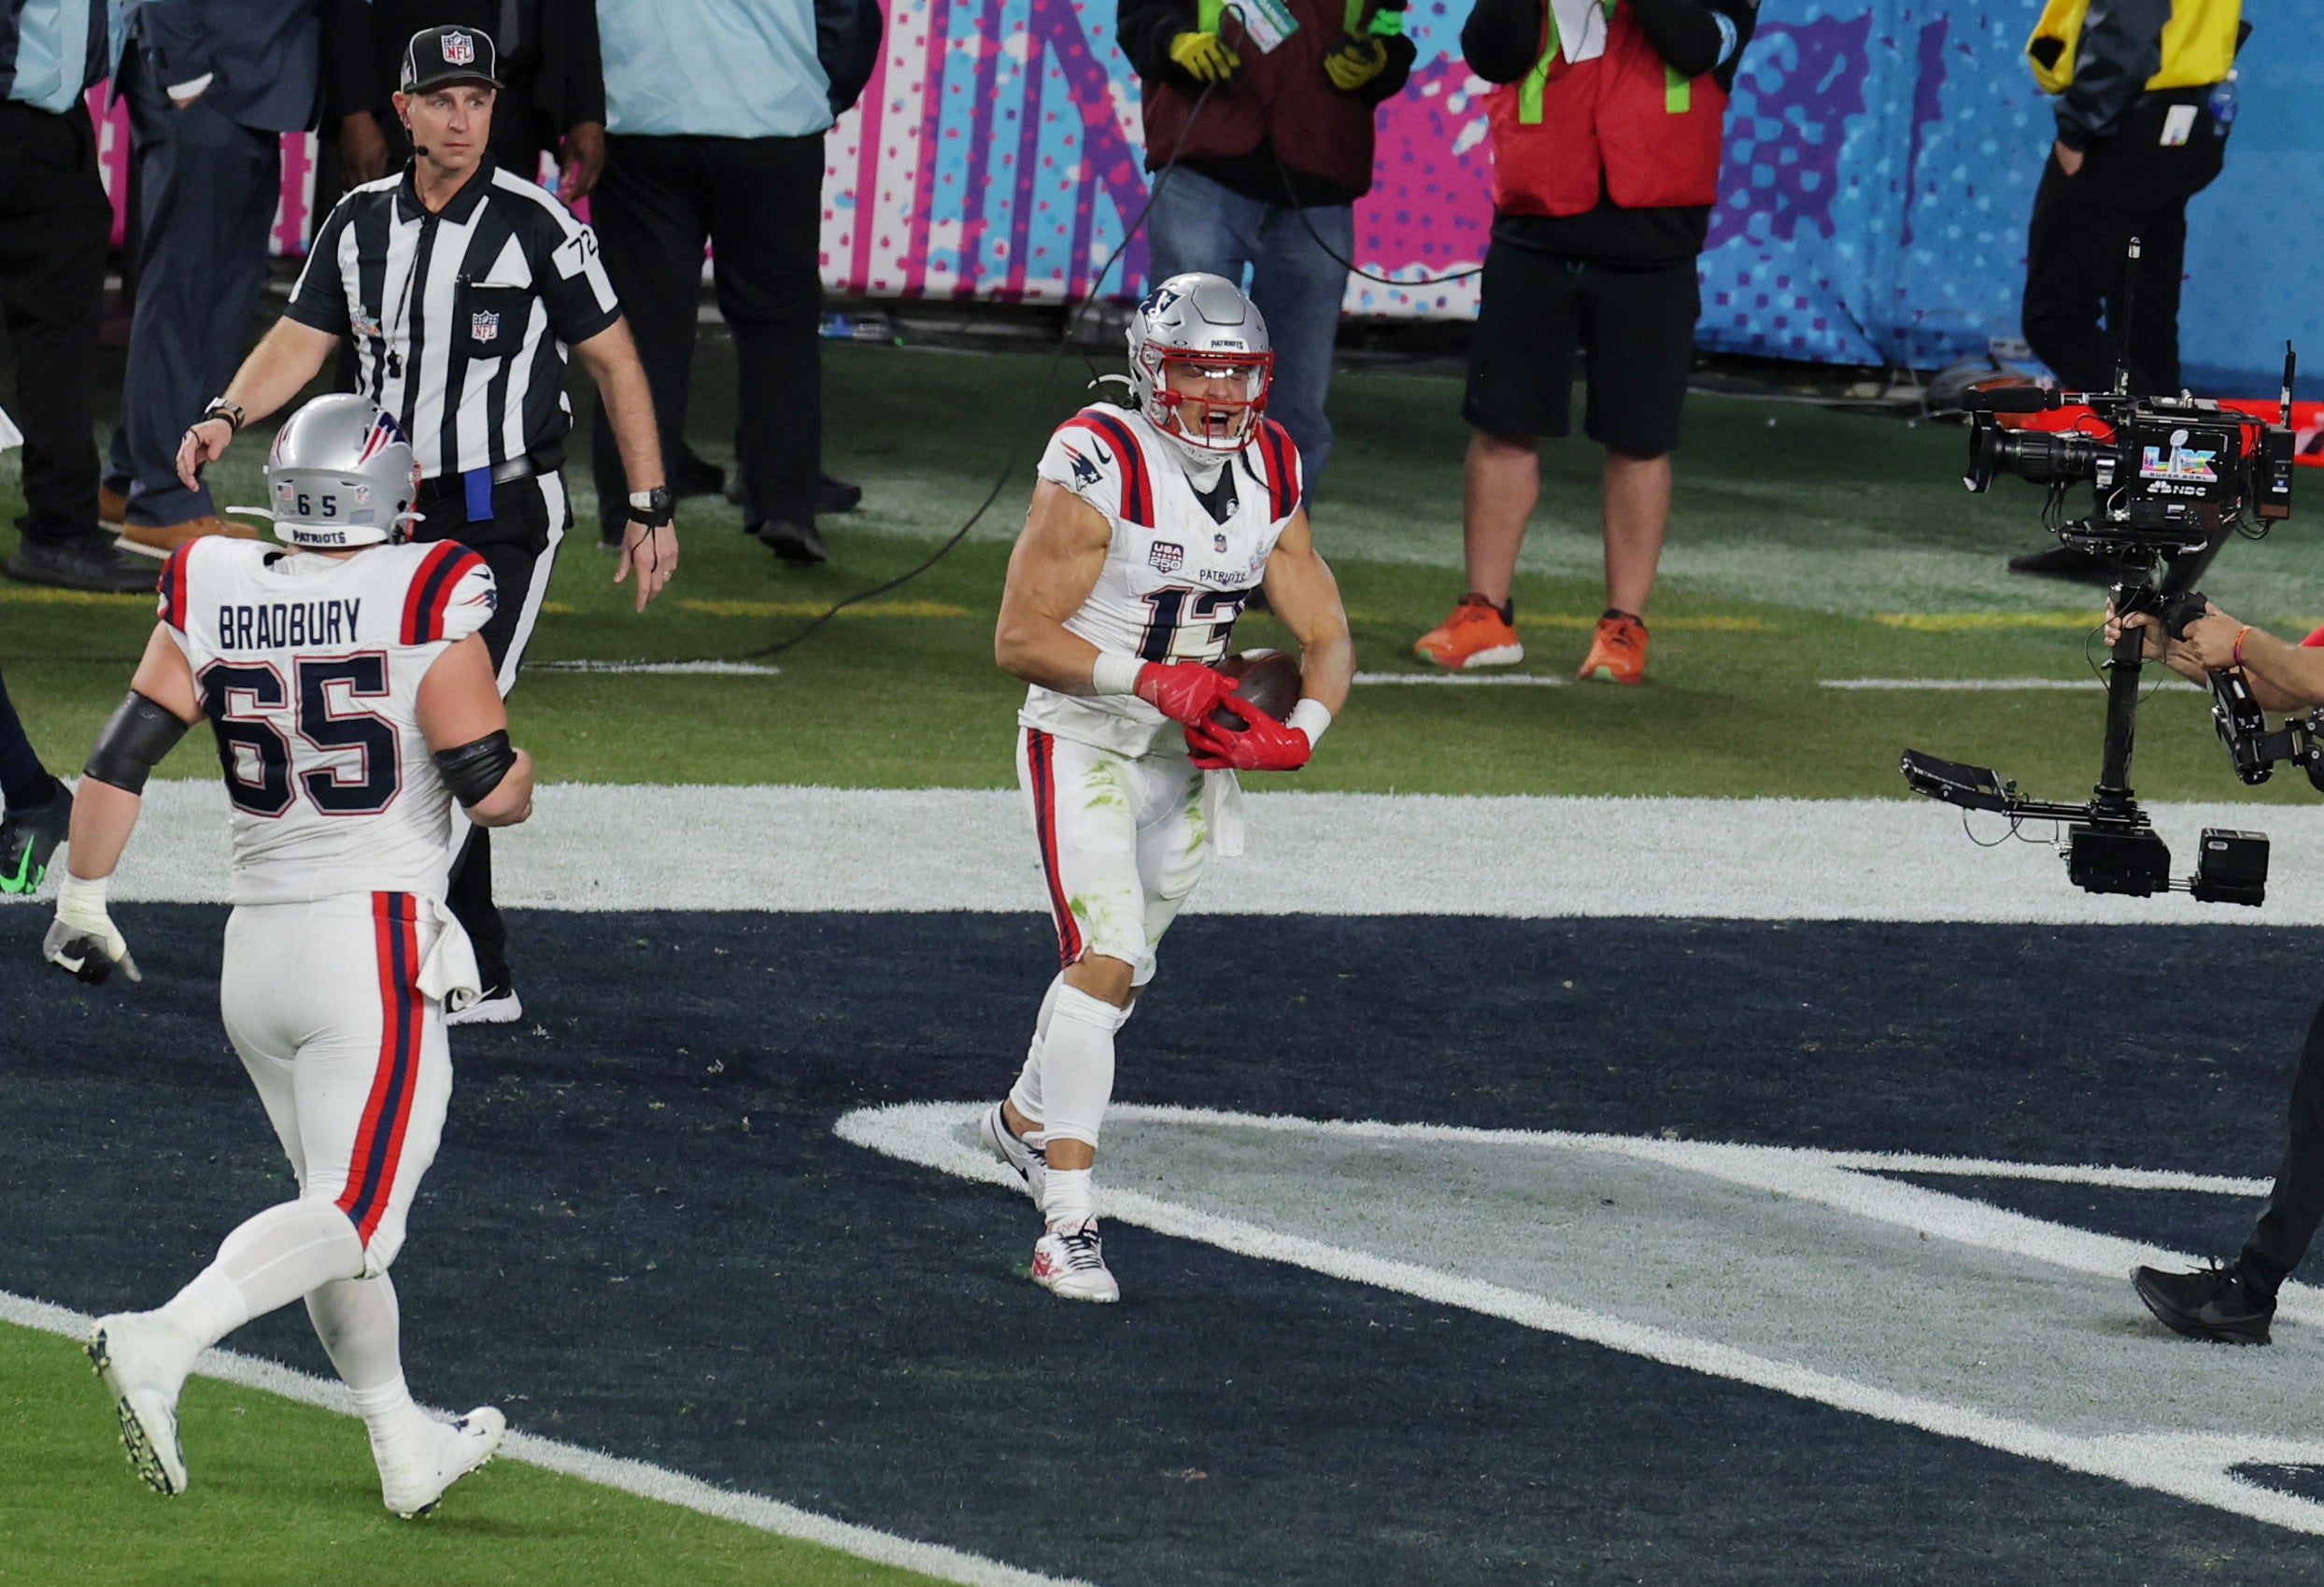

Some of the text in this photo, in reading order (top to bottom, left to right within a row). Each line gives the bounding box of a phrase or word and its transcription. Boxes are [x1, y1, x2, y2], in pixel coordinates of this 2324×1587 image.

[446, 45, 471, 60] NFL
[568, 230, 596, 265] 72
[475, 325, 495, 338] NFL
[1211, 339, 1243, 350] PATRIOTS
[2173, 485, 2206, 497] NBC
[292, 530, 347, 545] PATRIOTS
[1154, 543, 1182, 557] USA
[1150, 556, 1182, 571] 250
[220, 598, 361, 650] BRADBURY
[196, 649, 404, 819] 65
